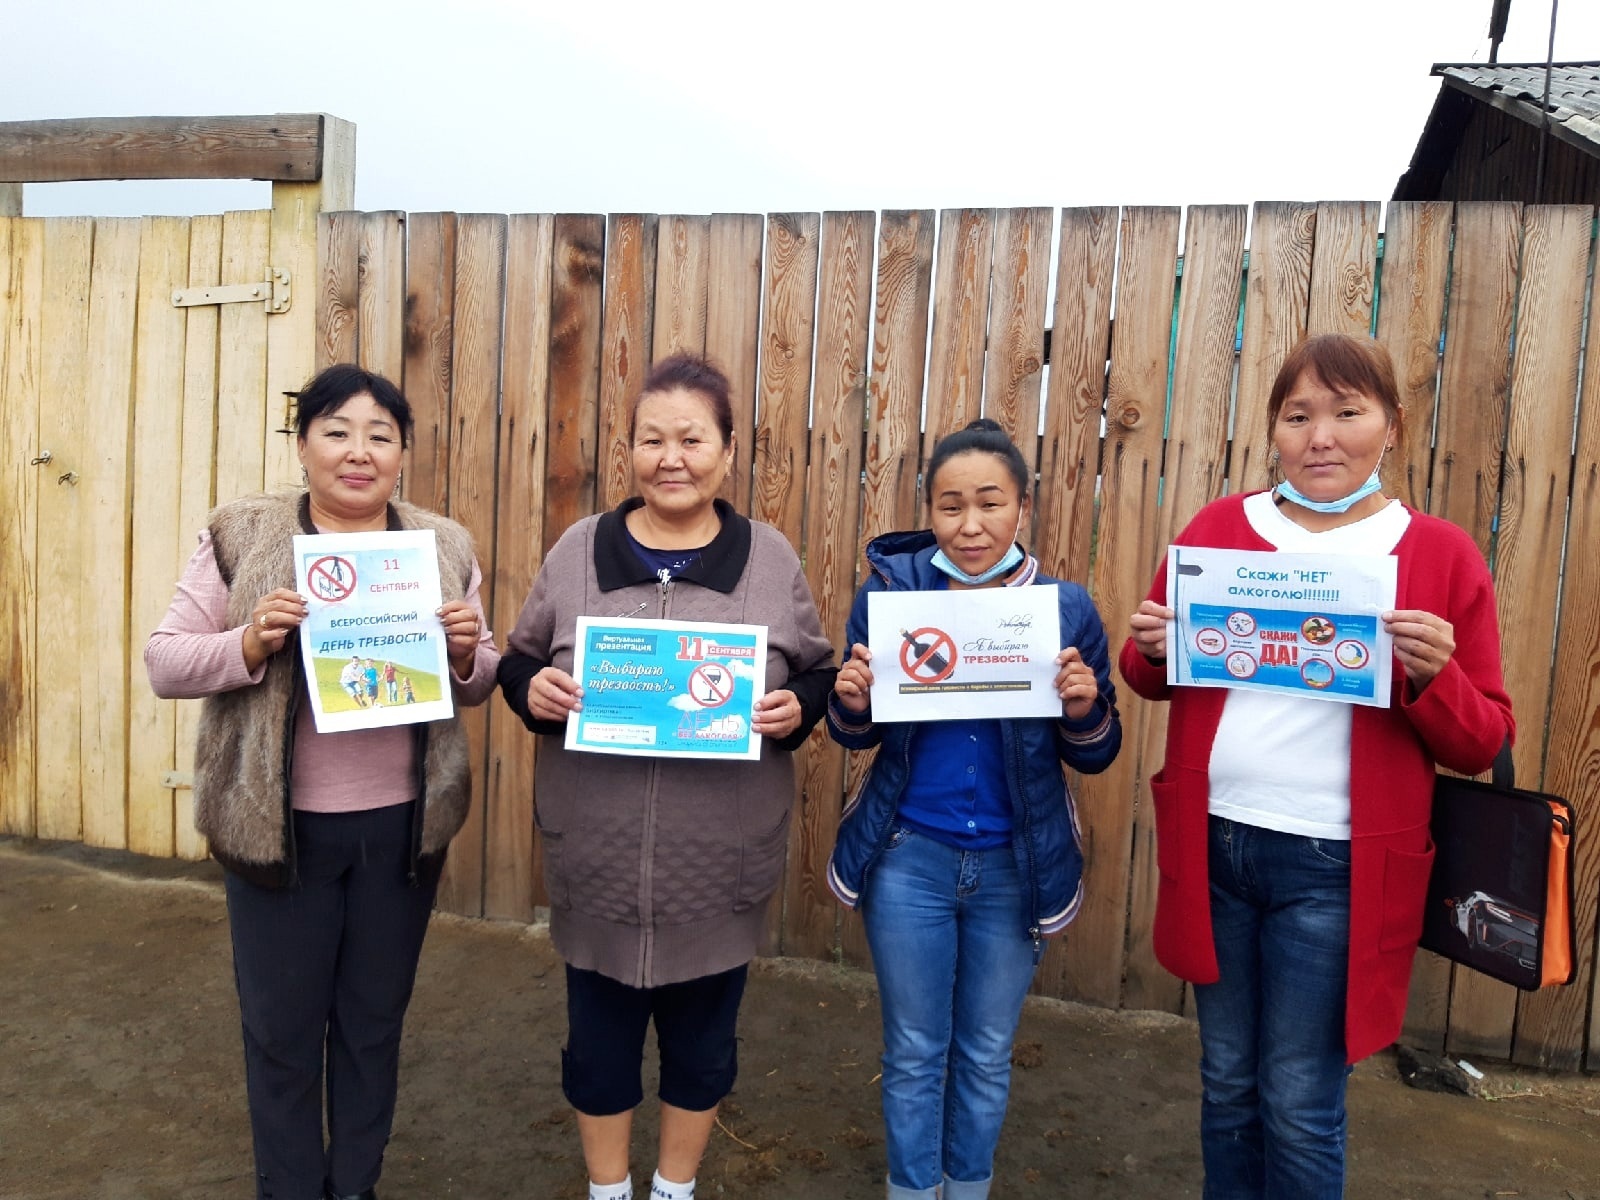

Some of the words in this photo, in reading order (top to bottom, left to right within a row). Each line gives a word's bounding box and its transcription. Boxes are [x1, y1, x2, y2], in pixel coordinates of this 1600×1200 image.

[384, 559, 400, 570] 11
[1236, 567, 1288, 581] Скажи
[1293, 570, 1332, 583] "НЕТ"
[370, 582, 419, 592] СЕНТЯБРЯ
[331, 611, 418, 628] ВСЕРОССИЙСКИЙ
[319, 639, 355, 653] ДЕНЬ
[358, 632, 427, 648] ТРЕЗВОСТИ
[603, 635, 645, 643] Виртуальная
[1260, 630, 1297, 642] СКАЖИ
[596, 643, 652, 651] презентация
[677, 636, 704, 661] 11
[709, 647, 752, 656] СЕНТЯБРЯ
[963, 638, 992, 651] Я
[988, 640, 1029, 653] выбираю
[963, 655, 1029, 664] ТРЕЗВОСТЬ
[1260, 644, 1298, 667] ДА!
[591, 660, 664, 679] «Выбираю
[588, 678, 675, 693] трезвость!»
[678, 711, 740, 732] ДЕНЬ
